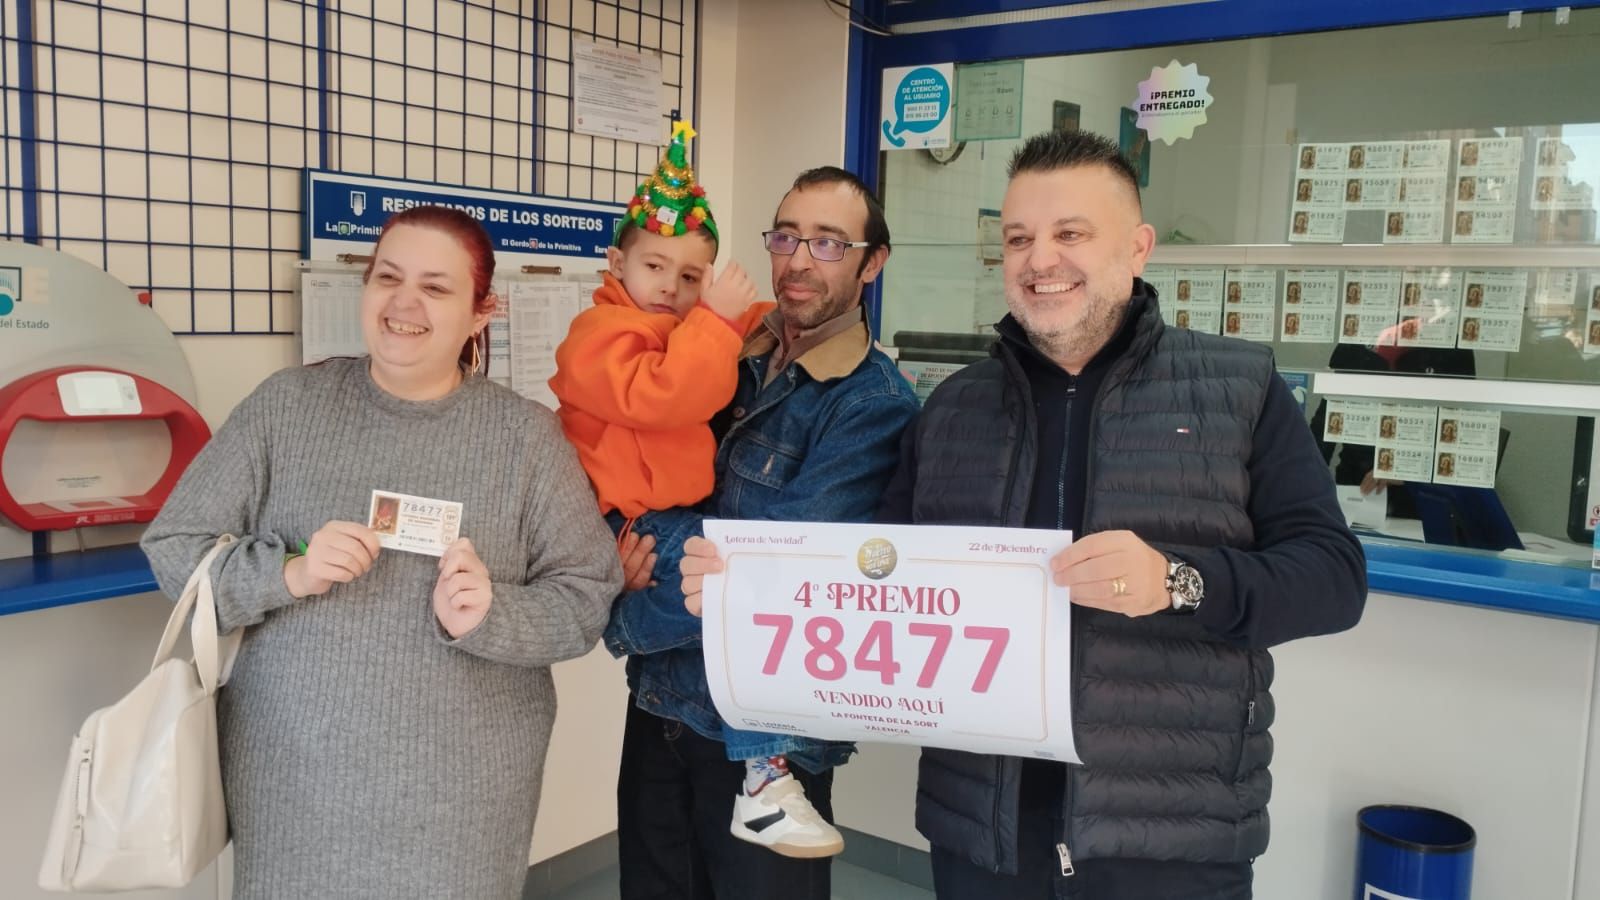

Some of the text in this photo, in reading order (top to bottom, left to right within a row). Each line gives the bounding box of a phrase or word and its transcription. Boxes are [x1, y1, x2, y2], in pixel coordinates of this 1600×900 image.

[910, 78, 936, 86] CENTRO
[911, 84, 944, 93] ATENCIÓN
[1150, 89, 1196, 100] ¡PREMIO
[913, 92, 942, 100] USUARIO
[1140, 99, 1205, 112] ENTREGADO!
[382, 197, 604, 232] RESDOS DE LOS SORTEOS
[325, 222, 338, 233] La
[501, 239, 582, 252] El Gordo de la Primitiva
[16, 319, 49, 329] Estado
[403, 502, 443, 517] 78477
[756, 536, 766, 544] de
[768, 535, 808, 546] Navidad
[968, 542, 1048, 554] 22 de Diciembre
[827, 582, 961, 617] PREMIO
[752, 613, 1011, 694] 78477
[813, 689, 945, 716] VENDIDO AQUÍ
[844, 713, 884, 724] FONTETA
[914, 720, 938, 728] SORT
[864, 725, 910, 734] VALENCIA
